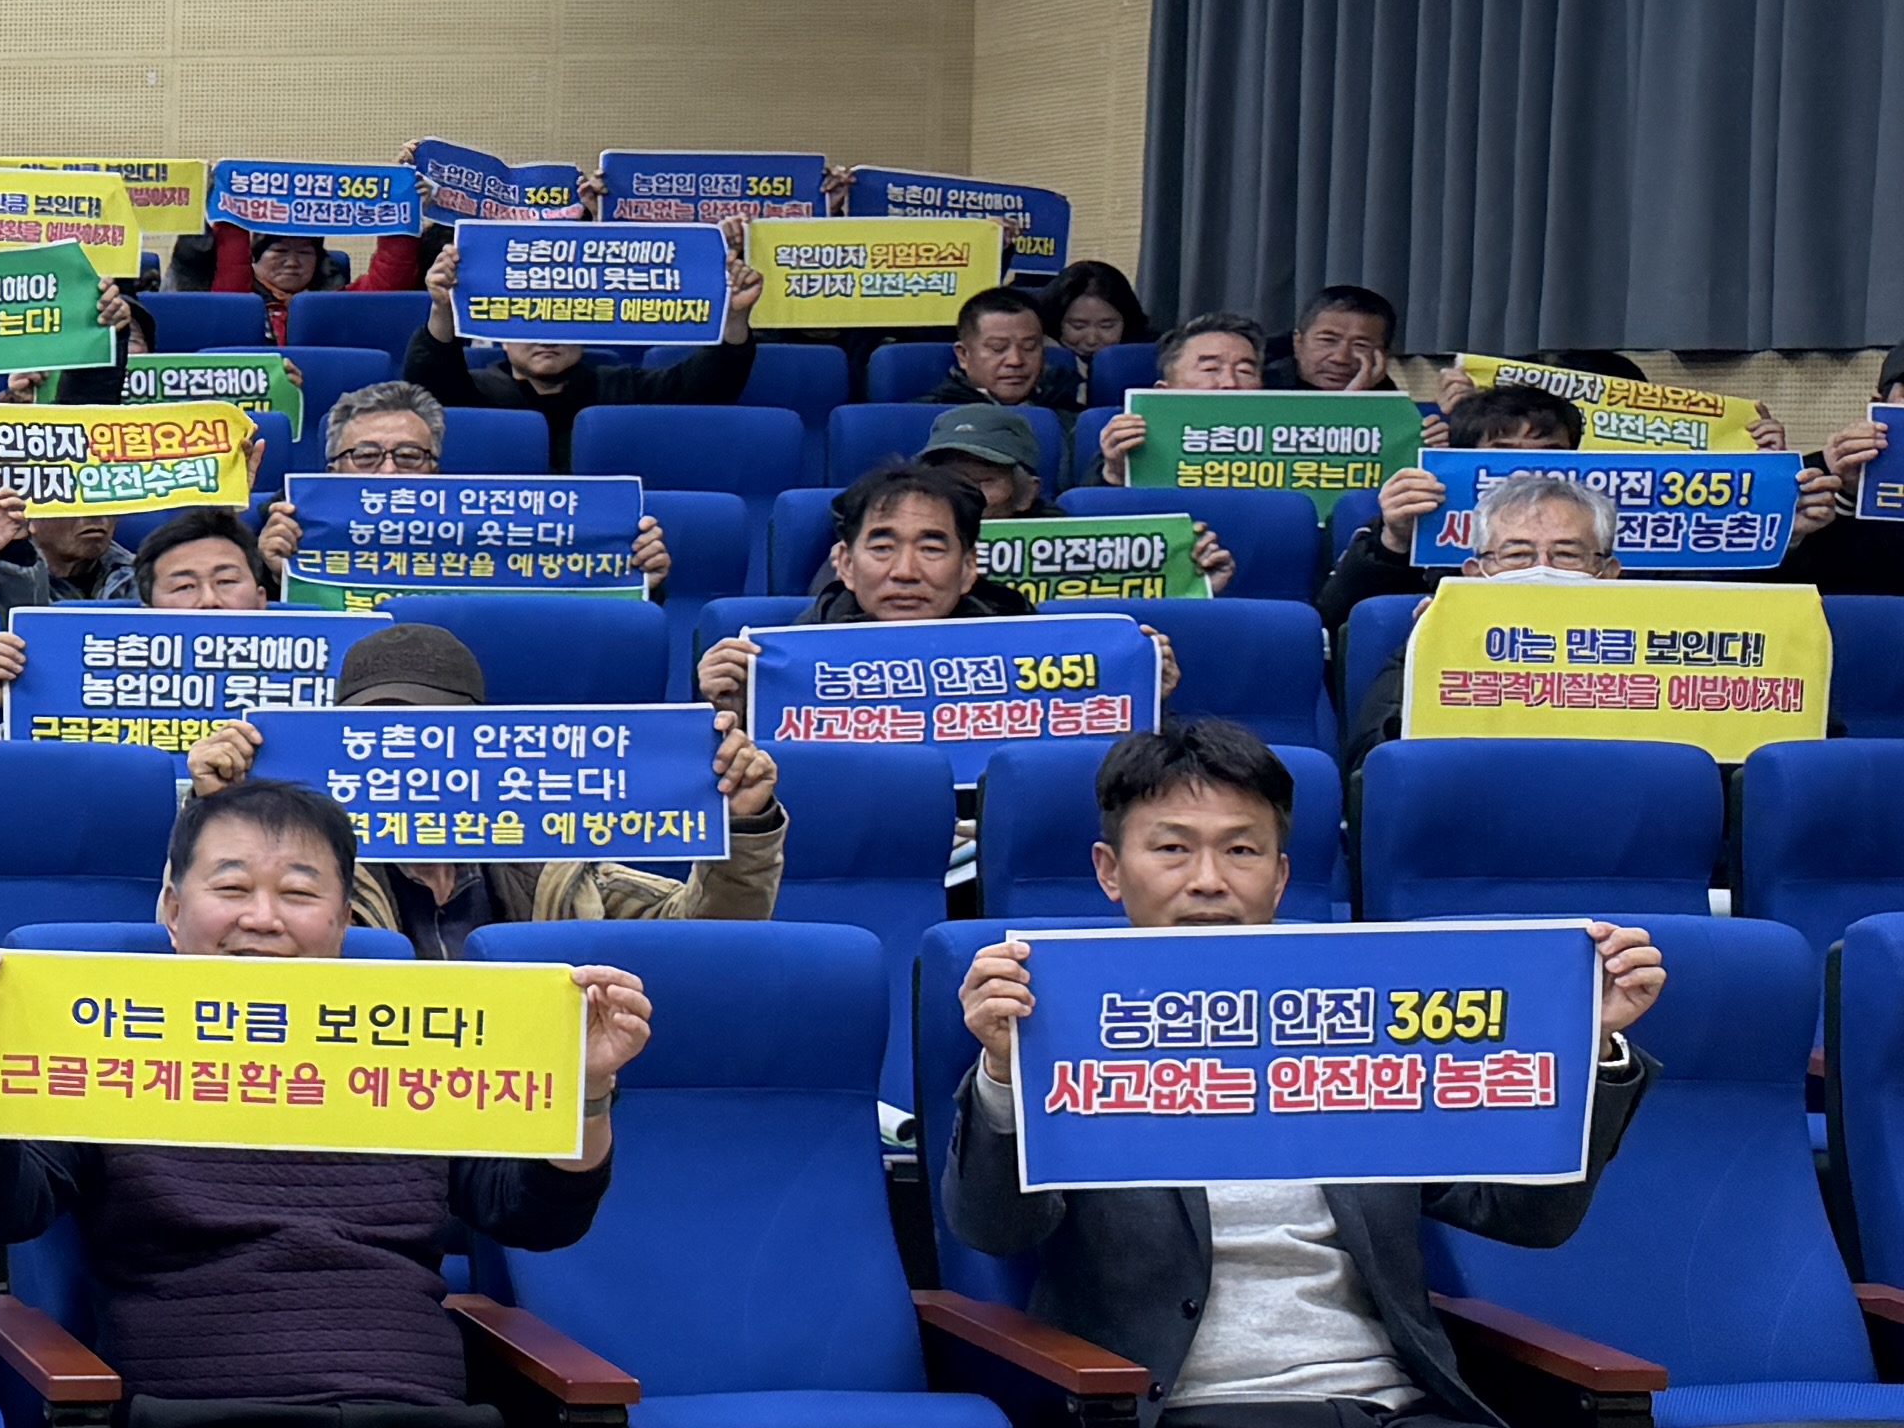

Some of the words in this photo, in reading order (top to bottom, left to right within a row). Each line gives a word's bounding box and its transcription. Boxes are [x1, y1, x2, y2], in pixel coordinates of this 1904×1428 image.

[229, 171, 289, 194] 농업인
[292, 174, 334, 198] 안전
[744, 175, 793, 197] 365!
[32, 194, 102, 219] 보인다!
[291, 201, 354, 227] 안전한
[504, 239, 576, 264] 농촌이
[582, 240, 677, 264] 안전해야
[774, 242, 866, 270] 확인하자
[468, 295, 615, 324] 근골격계질환을
[619, 296, 711, 324] 예방하자!
[91, 419, 232, 461] 위험요소!
[1181, 425, 1264, 455] 농촌이
[1271, 426, 1382, 456] 안전해야
[78, 458, 219, 498] 안전수칙!
[359, 488, 446, 515] 농촌이
[458, 489, 579, 516] 안전해야
[295, 549, 496, 578] 근골격계질환을
[506, 551, 633, 580] 예방하자!
[81, 633, 183, 669] 농촌이
[192, 635, 329, 672] 안전해야
[1484, 626, 1556, 663] 아는
[1565, 628, 1638, 666] 만큼
[1643, 630, 1766, 669] 보인다!
[813, 658, 927, 698] 농업인
[930, 654, 1009, 694] 안전
[1011, 652, 1098, 692] 365!
[1436, 670, 1662, 711] 근골격계질환을
[1666, 675, 1806, 714] 예방하자!
[774, 704, 927, 743] 사고없는
[931, 700, 1043, 740] 안전한
[1047, 693, 1133, 736] 농촌!
[341, 725, 456, 760] 농촌이
[472, 724, 631, 760] 안전해야
[541, 810, 707, 845] 예방하자!
[70, 996, 166, 1043] 아는
[193, 1000, 290, 1046] 만큼
[314, 1003, 486, 1050] 보인다!
[1097, 988, 1259, 1051] 농업인
[1269, 986, 1376, 1044] 안전
[1385, 988, 1507, 1045] 365!
[346, 1061, 555, 1113] 예방하자!
[1042, 1059, 1258, 1117] 사고없는
[1265, 1050, 1427, 1113] 안전한
[1432, 1050, 1561, 1112] 농촌!
